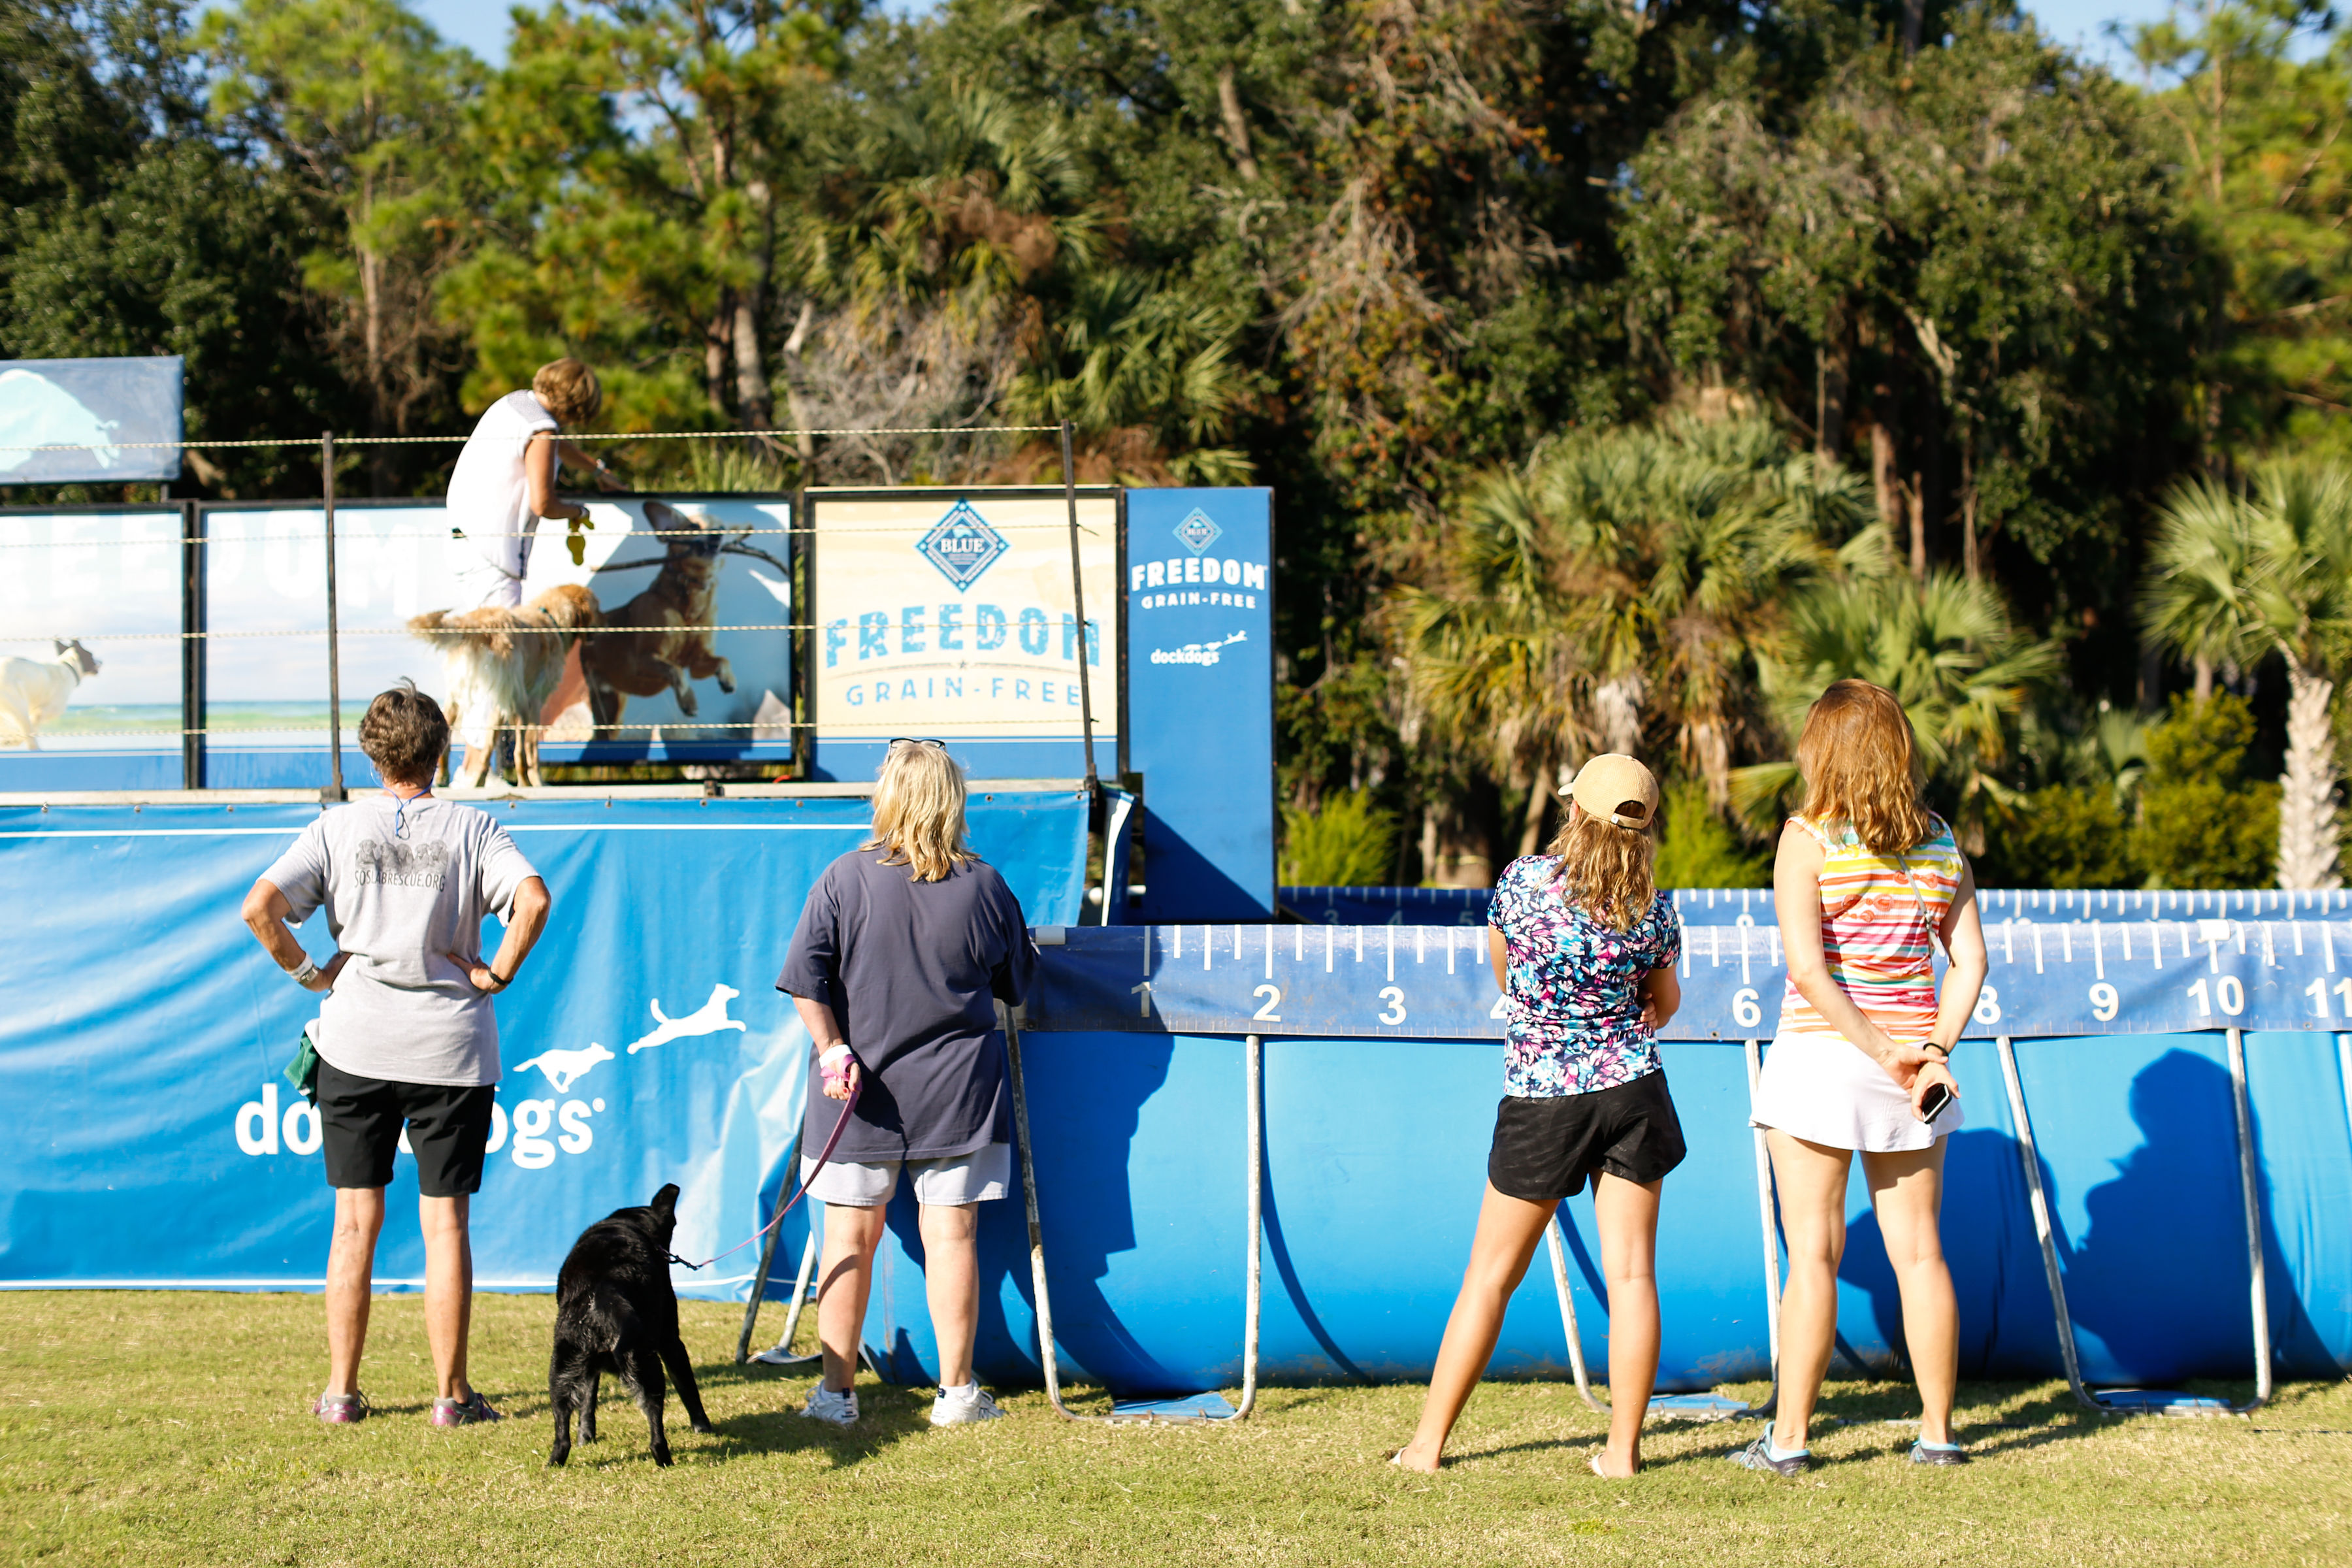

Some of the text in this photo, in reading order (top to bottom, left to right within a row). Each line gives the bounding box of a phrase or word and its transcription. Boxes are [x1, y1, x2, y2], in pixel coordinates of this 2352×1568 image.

[941, 538, 985, 553] BLUE
[1132, 557, 1265, 591] FREEDOM
[1141, 592, 1256, 609] GRAIN-FREE
[826, 604, 1100, 668] FREEDOM
[1151, 648, 1220, 666] dockdogs
[845, 678, 1081, 706] GRAIN-FREE
[355, 869, 446, 892] SOSLABRESCUE.ORG
[1132, 981, 1151, 1017] 1
[1252, 984, 1281, 1022] 2
[1378, 986, 1407, 1025] 3
[1731, 988, 1761, 1027] 6
[1973, 985, 2001, 1024] 8
[2089, 982, 2119, 1021] 9
[2187, 975, 2245, 1017] 10
[2305, 977, 2352, 1018] 11
